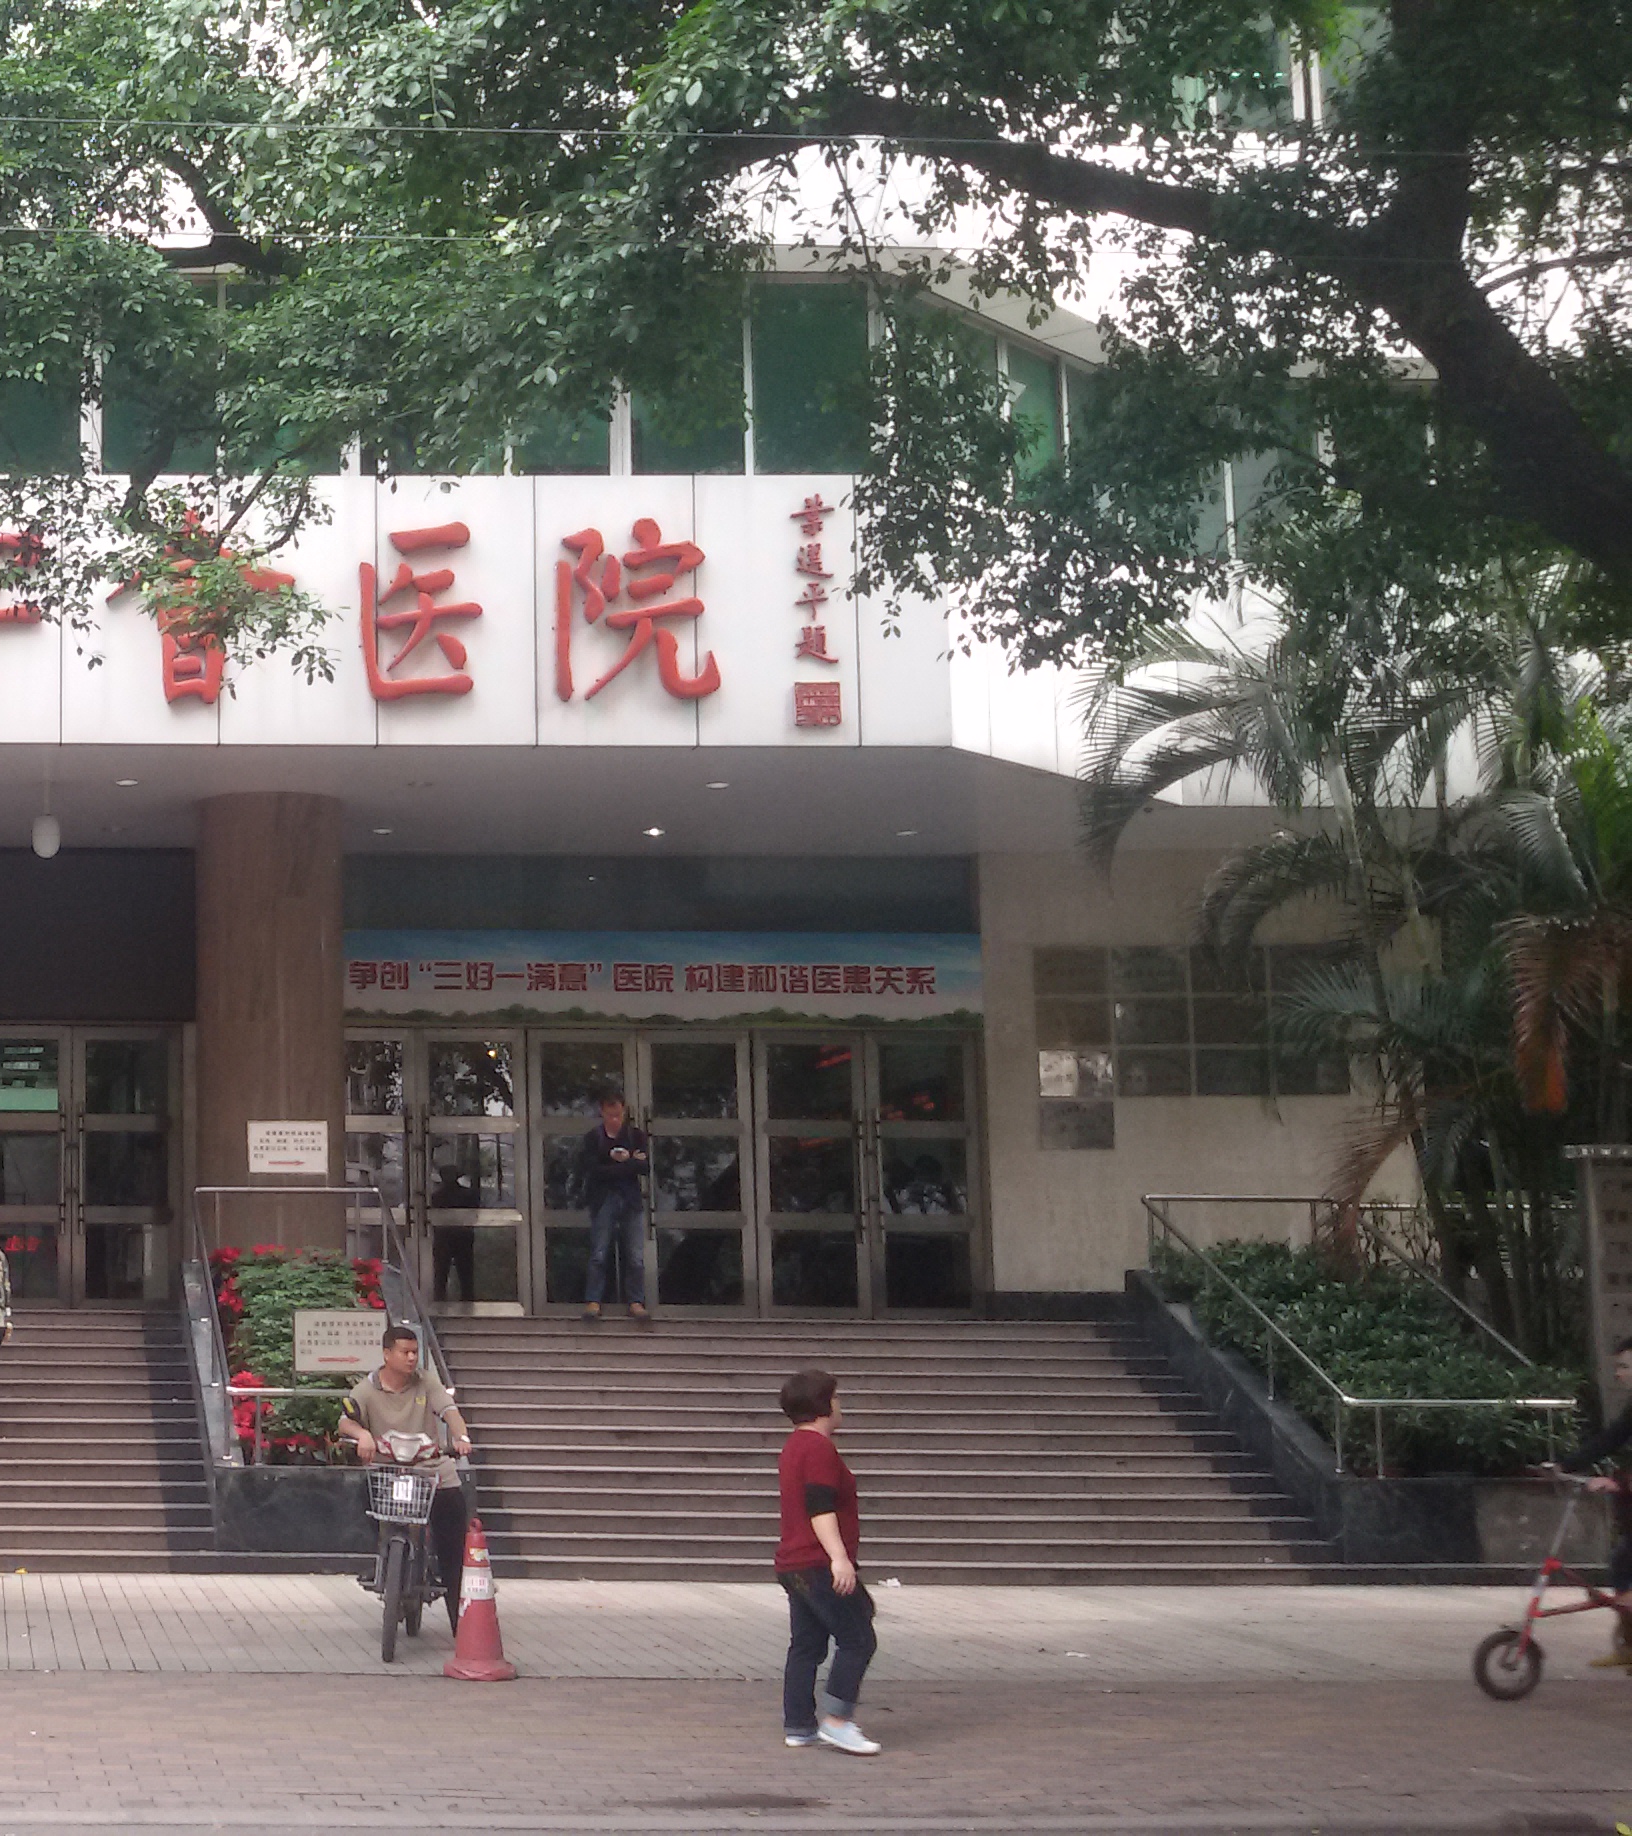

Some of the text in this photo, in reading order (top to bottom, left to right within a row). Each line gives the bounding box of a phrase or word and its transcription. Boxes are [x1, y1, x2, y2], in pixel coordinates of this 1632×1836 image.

[684, 961, 938, 996] 构建和谐医患关系
